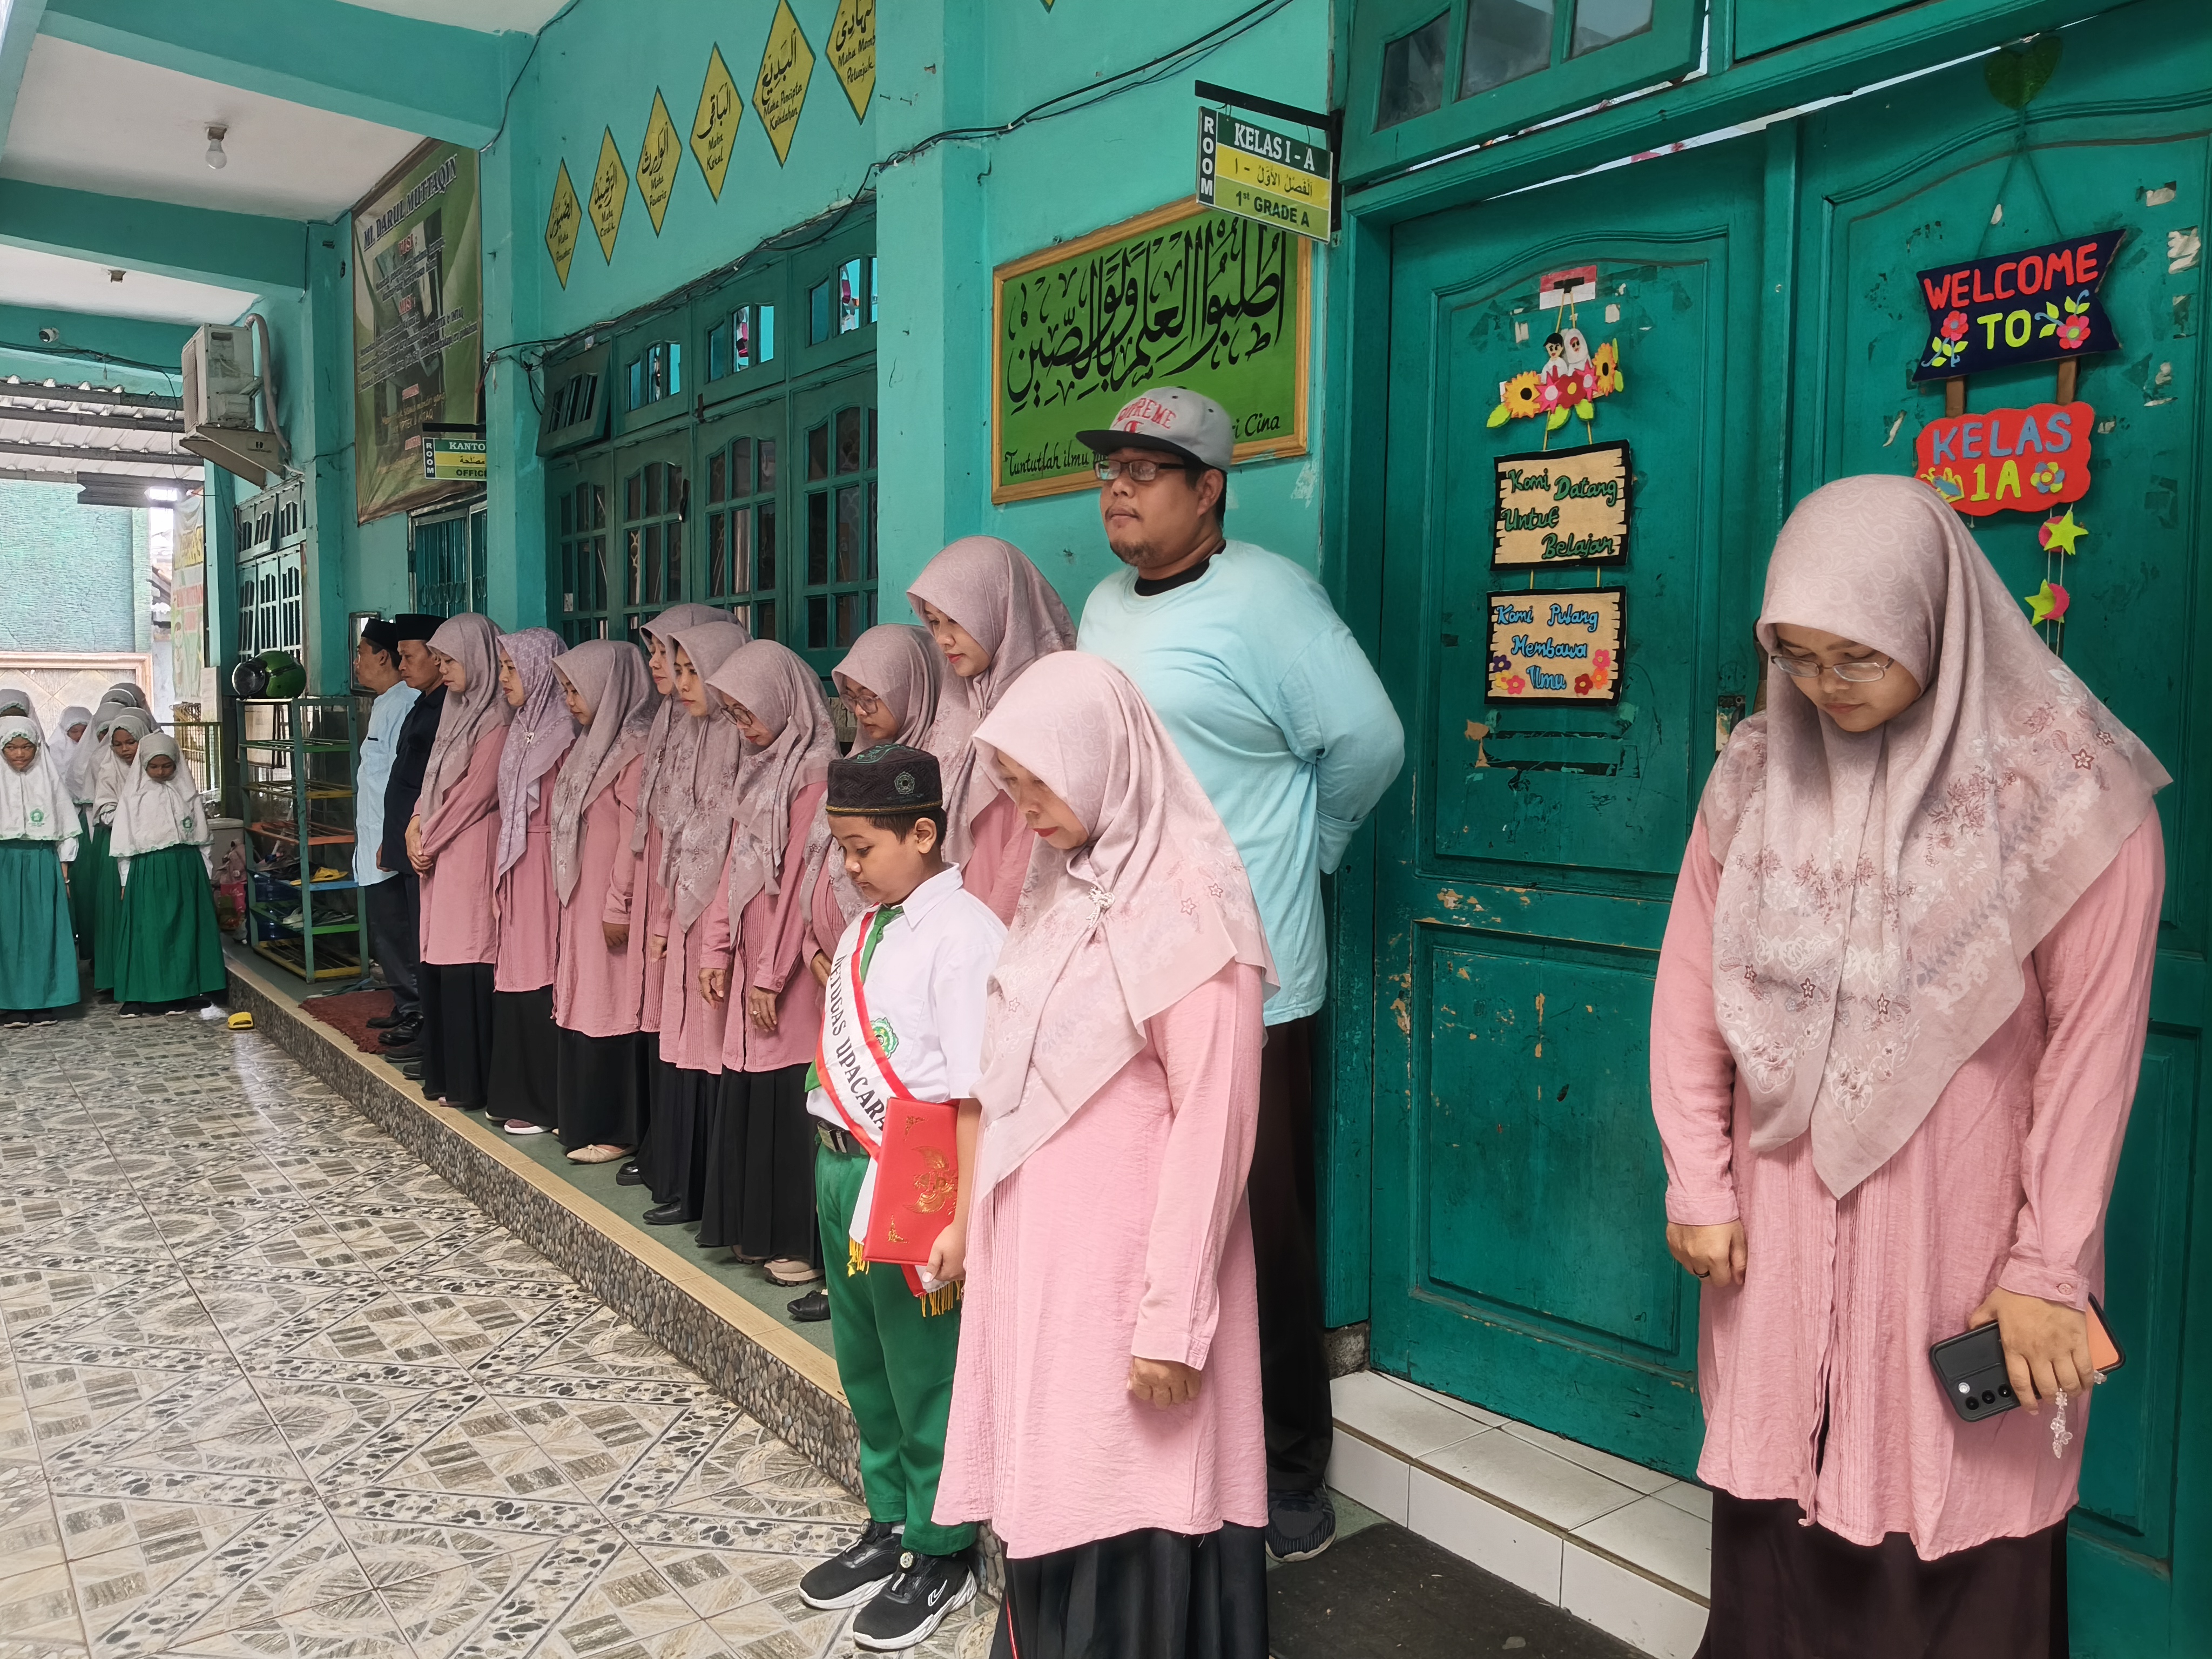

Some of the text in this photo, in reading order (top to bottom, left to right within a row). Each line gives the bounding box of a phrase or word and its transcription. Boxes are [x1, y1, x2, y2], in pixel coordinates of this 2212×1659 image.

[1201, 116, 1214, 197] ROOM
[1235, 123, 1282, 160] KELAS
[1304, 148, 1315, 171] A
[376, 199, 405, 241] DARUL
[406, 155, 457, 217] MUTTAQIN
[1254, 197, 1297, 223] GRADE
[1301, 211, 1310, 227] A
[1923, 242, 2098, 310] WELCOME
[1977, 309, 2032, 349] TO
[1245, 413, 1281, 437] Cina
[1933, 412, 2071, 465] KELAS
[449, 442, 485, 450] KANTO
[1004, 442, 1061, 476] Tuntutlah
[1063, 440, 1089, 468] ilmu
[1553, 475, 1618, 507] Datang
[1970, 460, 2021, 502] 1A
[1541, 533, 1615, 559] Belajar
[1547, 603, 1599, 632] Pulang
[1511, 635, 1587, 659] Membawa
[1526, 666, 1566, 690] Ilmu
